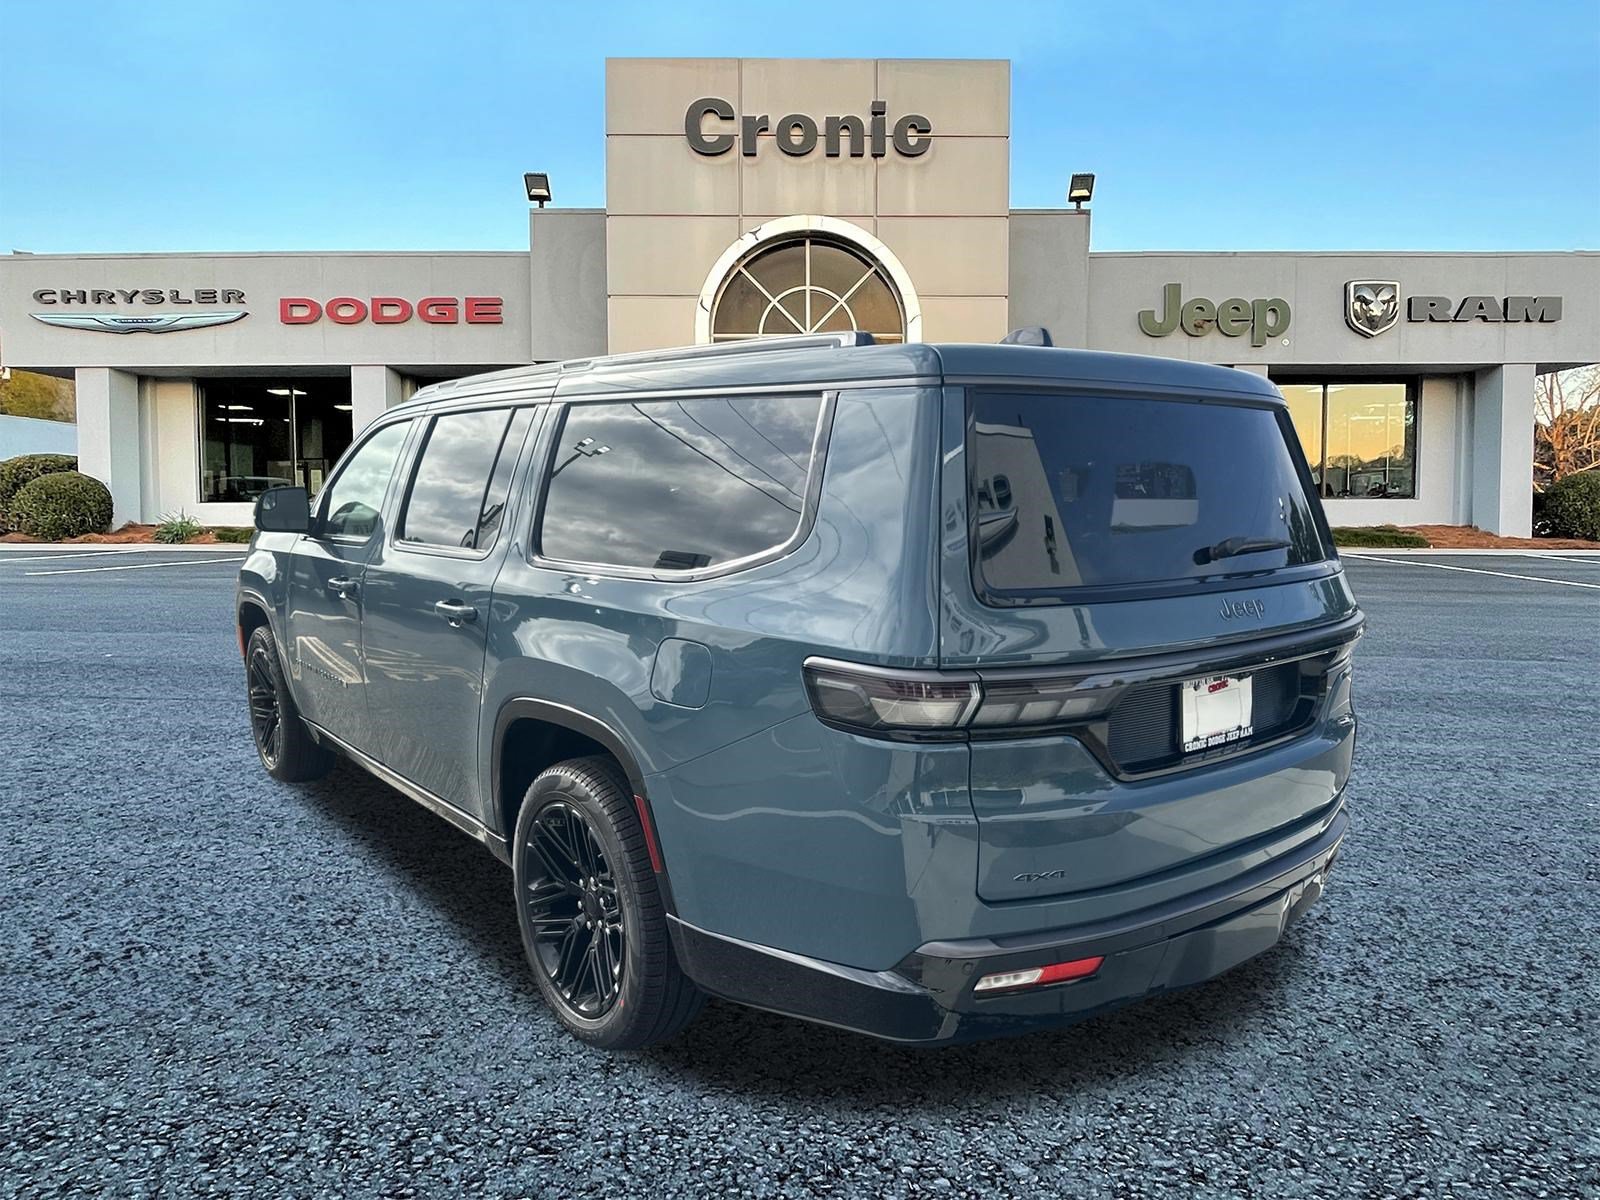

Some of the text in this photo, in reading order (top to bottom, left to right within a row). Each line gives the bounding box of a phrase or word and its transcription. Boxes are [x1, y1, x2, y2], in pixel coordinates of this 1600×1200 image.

[684, 97, 932, 158] Cronic
[32, 288, 247, 305] CHRYSLER
[1407, 296, 1562, 323] RAM
[280, 297, 504, 325] DODGE
[1138, 283, 1291, 347] Jeep
[1220, 598, 1264, 621] Jeep
[1184, 739, 1207, 753] CRONIC
[1207, 734, 1226, 747] DODGE
[1226, 730, 1240, 742] JEEP
